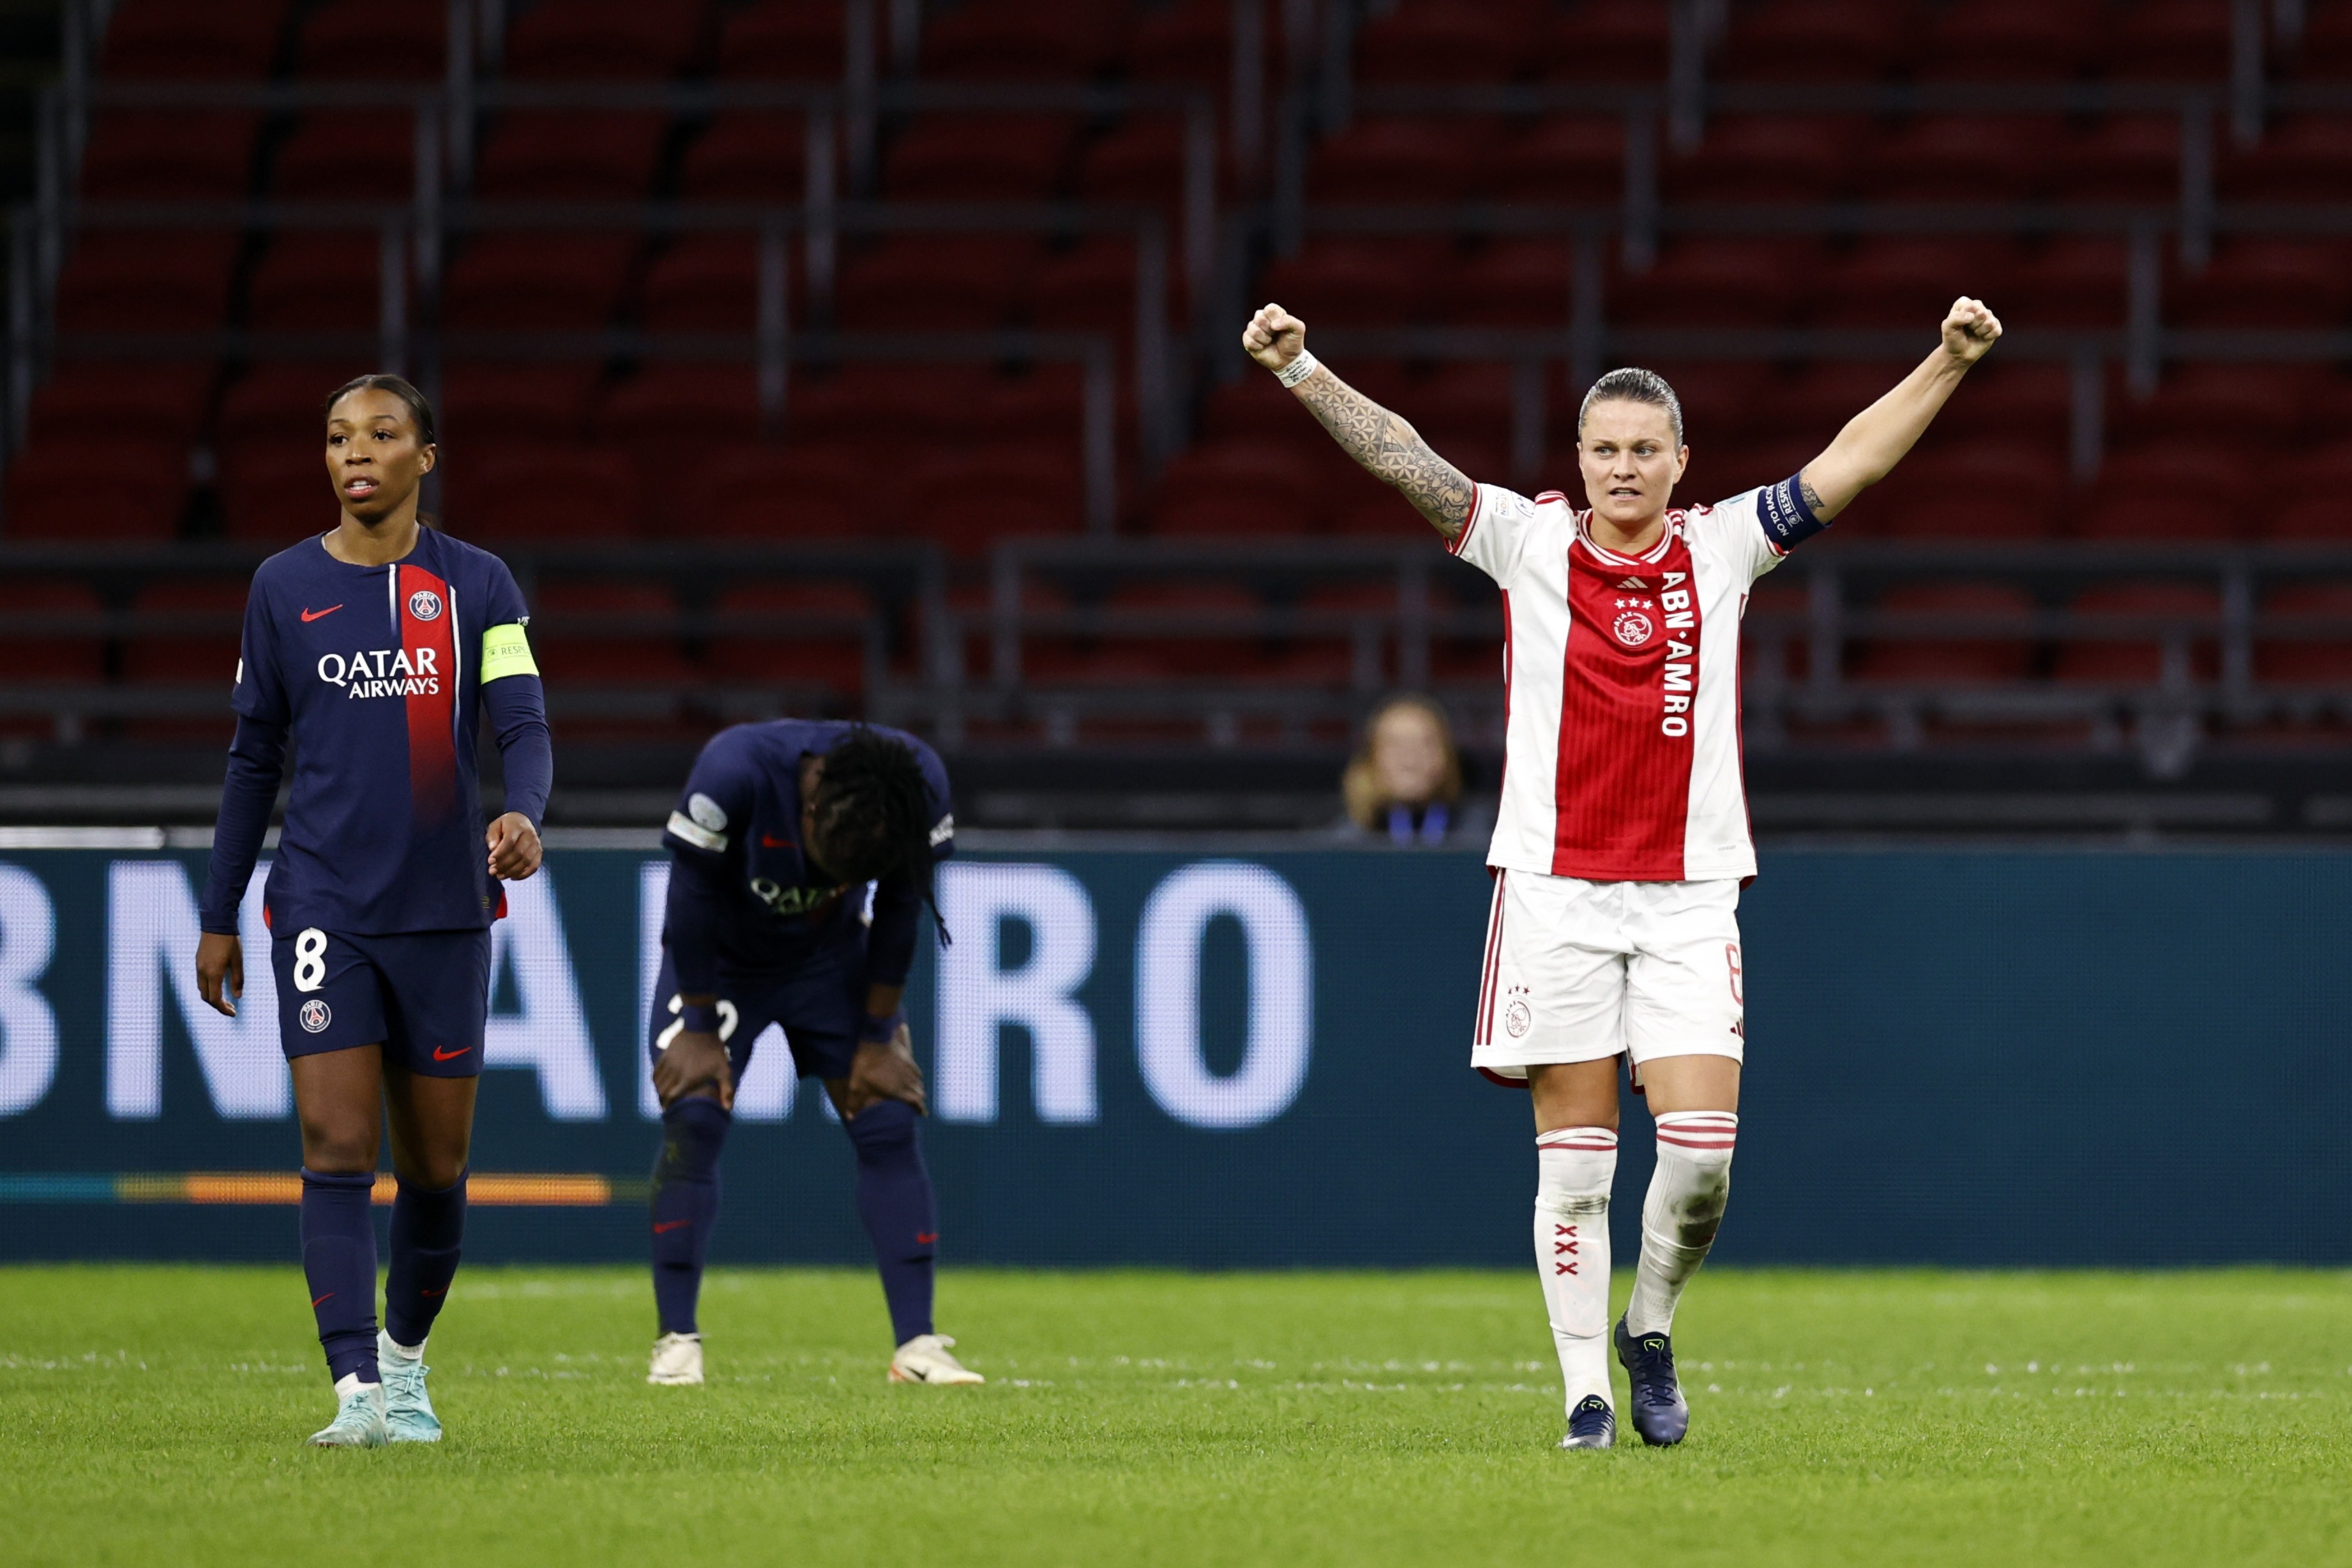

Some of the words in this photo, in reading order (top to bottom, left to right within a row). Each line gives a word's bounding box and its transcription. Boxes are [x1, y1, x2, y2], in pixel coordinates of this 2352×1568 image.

[1770, 511, 1781, 524] TO
[1777, 524, 1790, 536] NO
[1614, 612, 1632, 626] AJAX
[318, 647, 439, 688] QATAR
[349, 677, 439, 700] AIRWAYS
[294, 927, 327, 992] 8
[303, 1002, 323, 1012] PARIS
